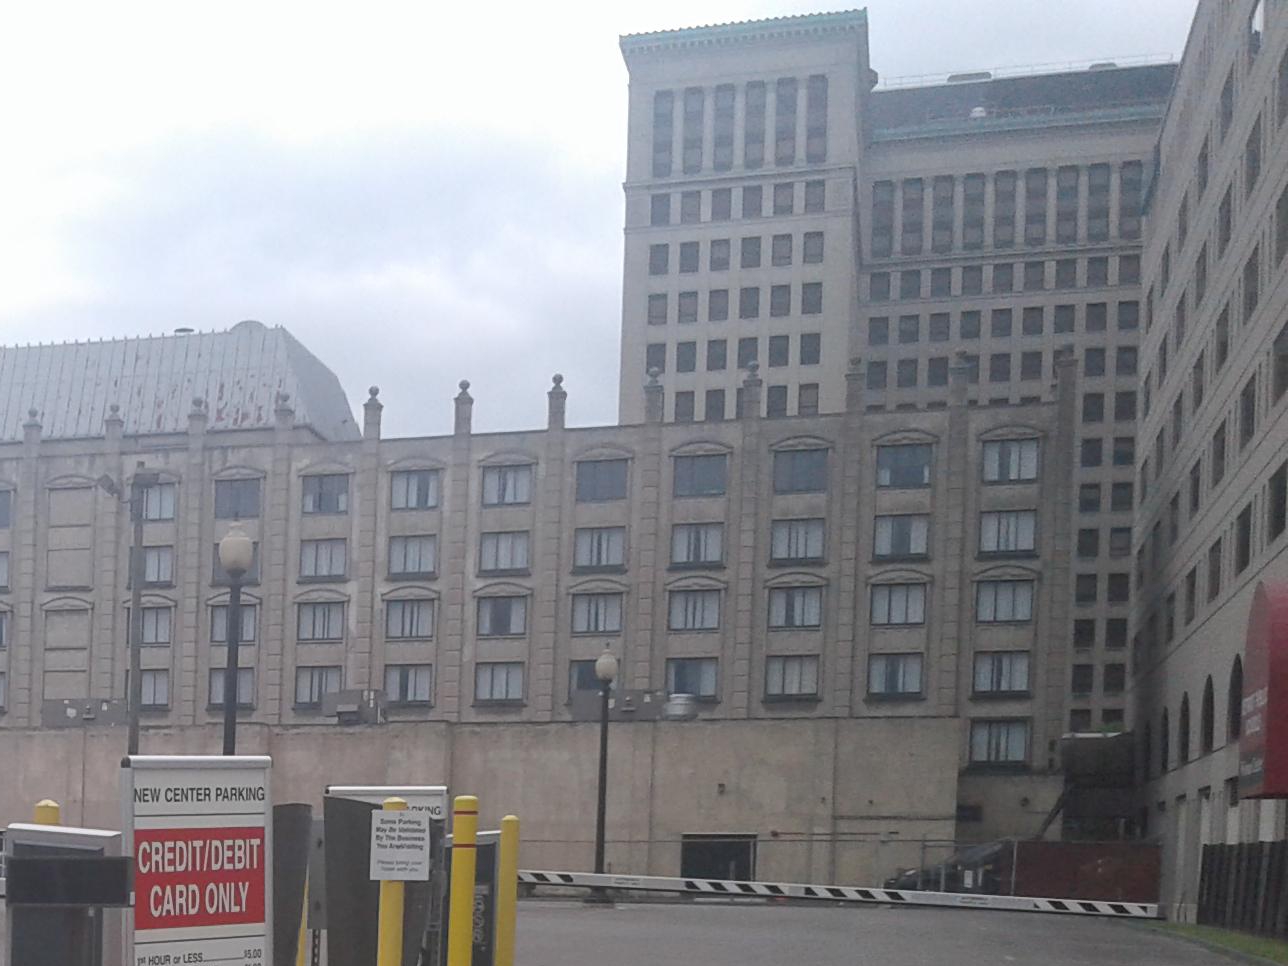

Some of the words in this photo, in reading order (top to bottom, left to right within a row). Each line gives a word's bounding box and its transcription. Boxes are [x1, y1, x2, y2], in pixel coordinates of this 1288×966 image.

[134, 787, 161, 802] NEW
[164, 787, 211, 802] CENTER
[215, 786, 265, 801] PARKING
[138, 838, 261, 874] CREDIT/DEBIT
[149, 883, 200, 918] CARD
[205, 881, 250, 914] ONLY
[148, 954, 171, 966] HOUR
[173, 956, 181, 964] or
